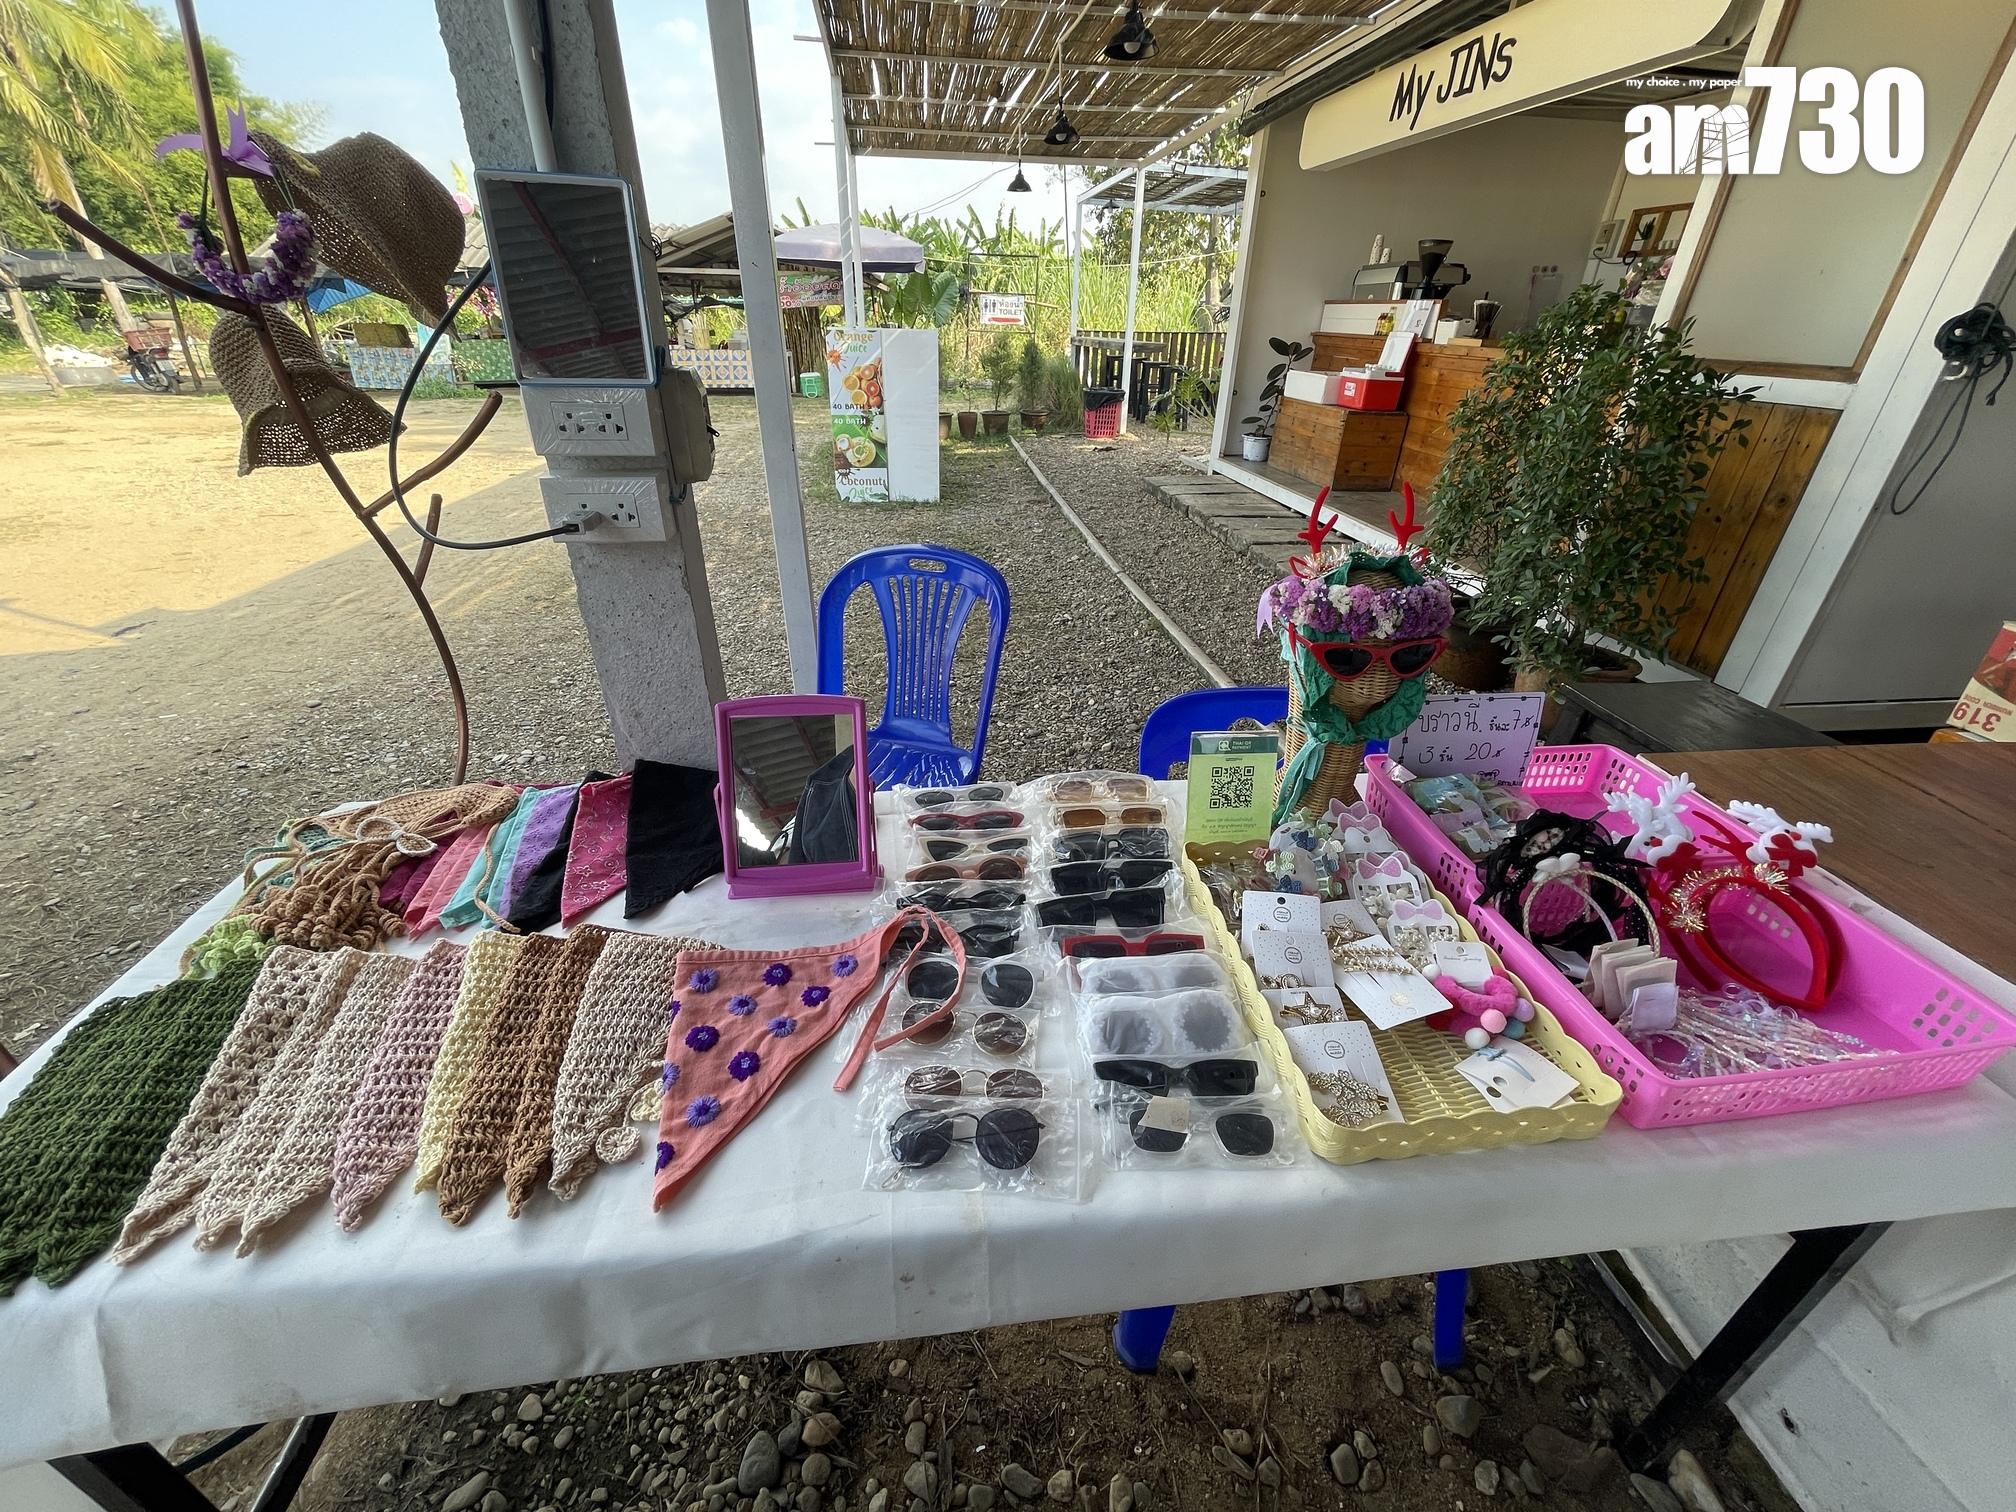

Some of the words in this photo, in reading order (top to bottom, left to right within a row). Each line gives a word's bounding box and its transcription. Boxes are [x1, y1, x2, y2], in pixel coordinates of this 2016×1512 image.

[834, 331, 873, 344] Orange
[840, 475, 883, 486] Coconut
[1953, 702, 2001, 732] 319
[1418, 746, 1434, 764] 3
